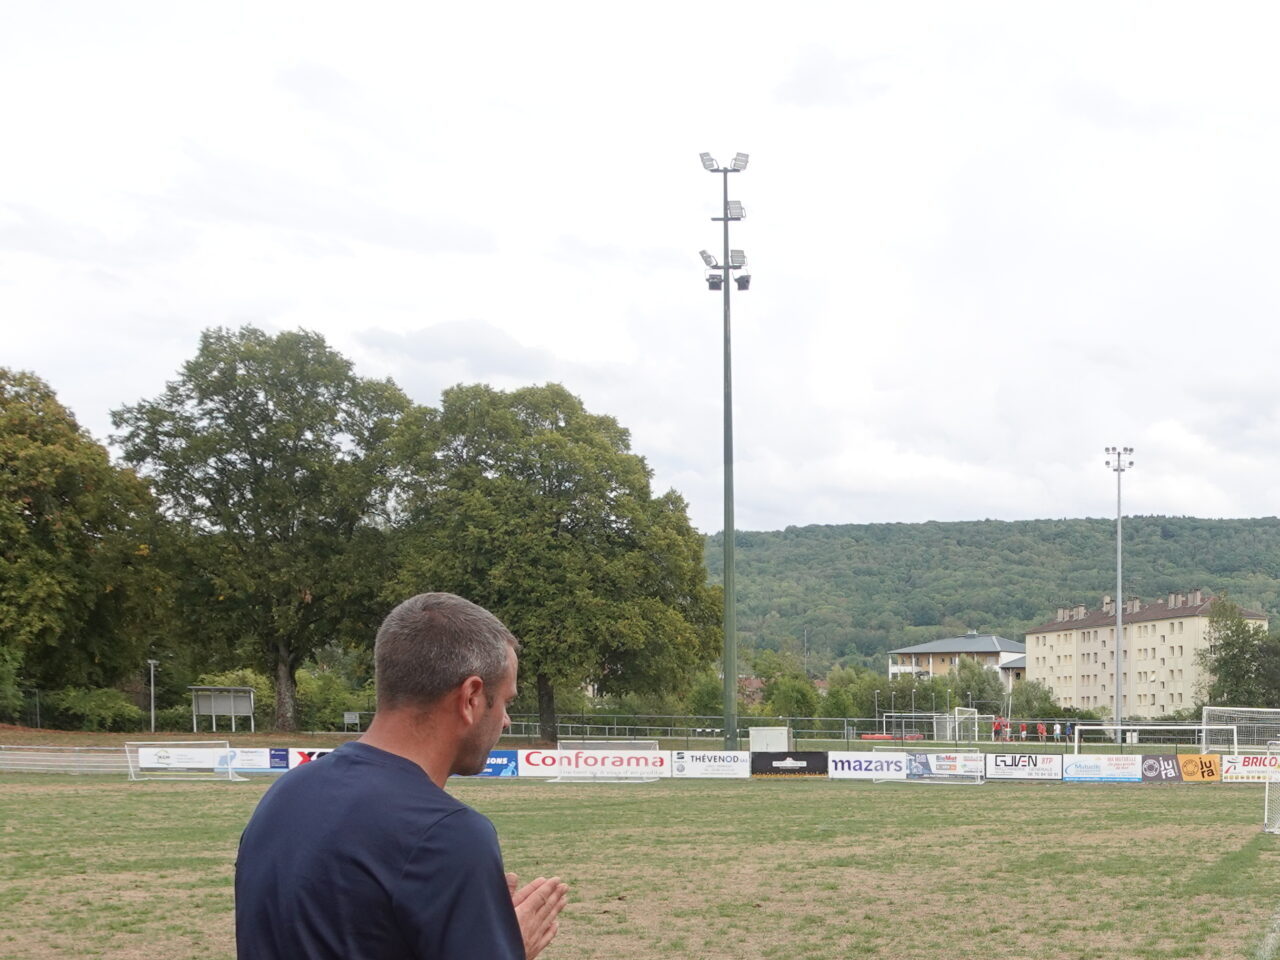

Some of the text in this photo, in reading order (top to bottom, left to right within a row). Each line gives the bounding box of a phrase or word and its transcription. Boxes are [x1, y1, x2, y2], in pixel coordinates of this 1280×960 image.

[525, 751, 665, 769] Conforama
[691, 754, 739, 763] THÉVENOD
[1242, 756, 1278, 767] BRICO
[832, 760, 903, 772] mazars
